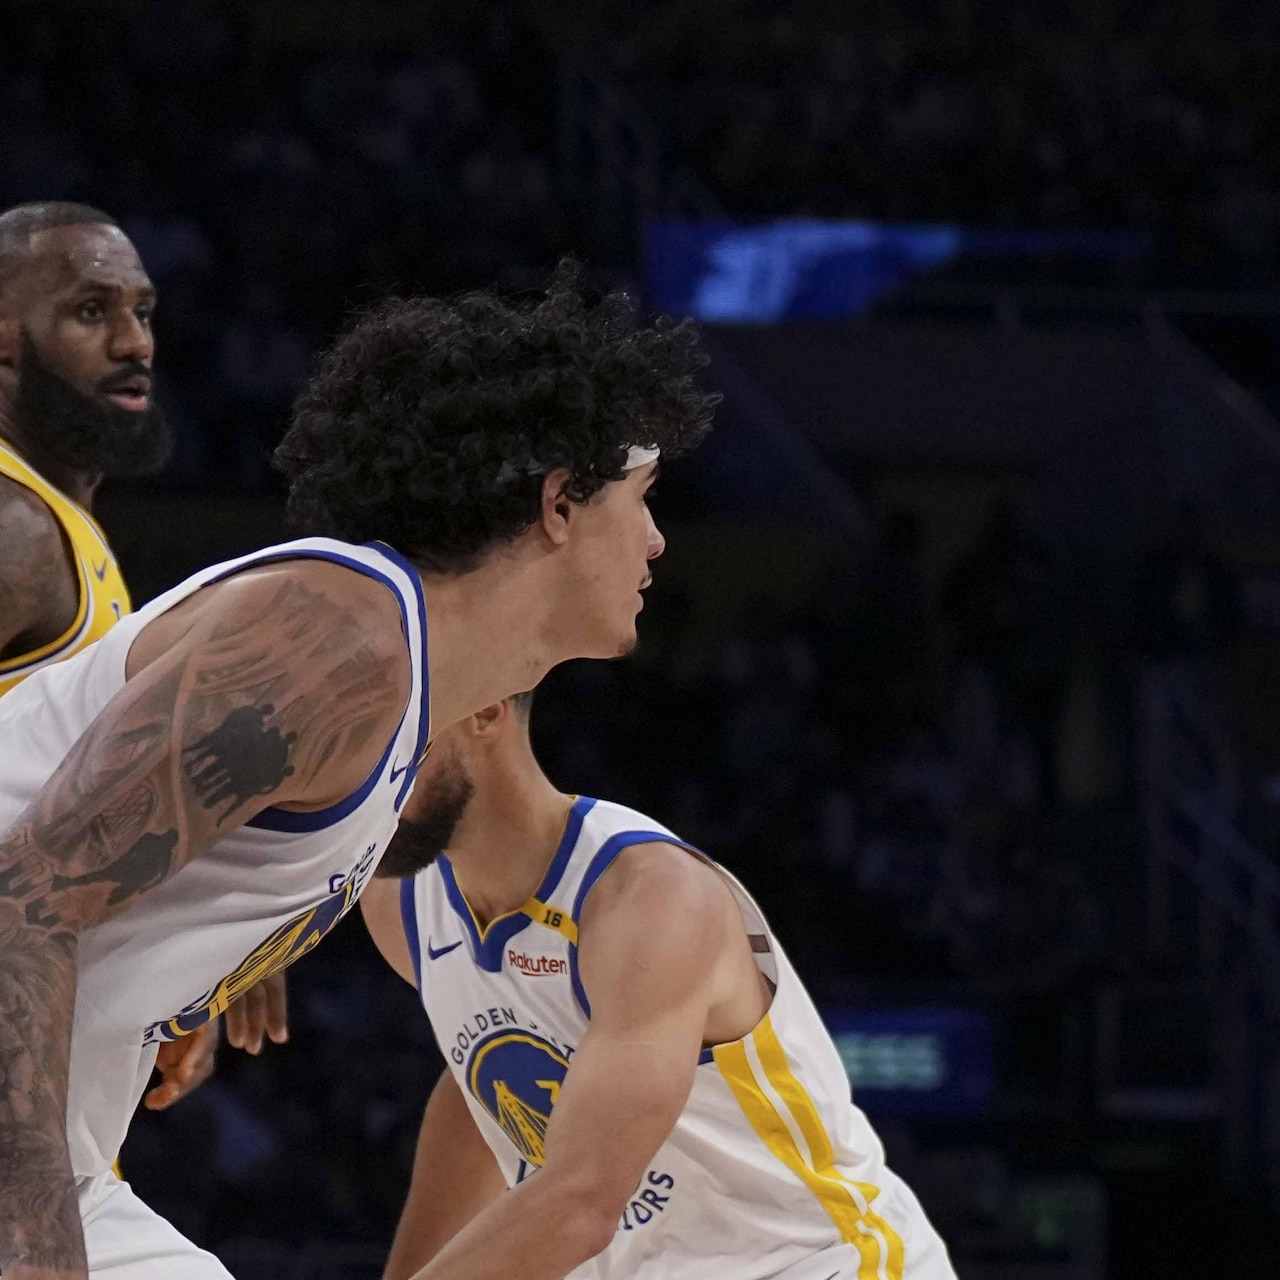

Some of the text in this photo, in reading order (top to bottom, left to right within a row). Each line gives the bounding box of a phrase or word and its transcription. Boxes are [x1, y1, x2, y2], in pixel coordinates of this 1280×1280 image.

[543, 908, 564, 928] 16
[508, 950, 568, 975] Rakuten
[451, 1006, 518, 1065] GOLDEN
